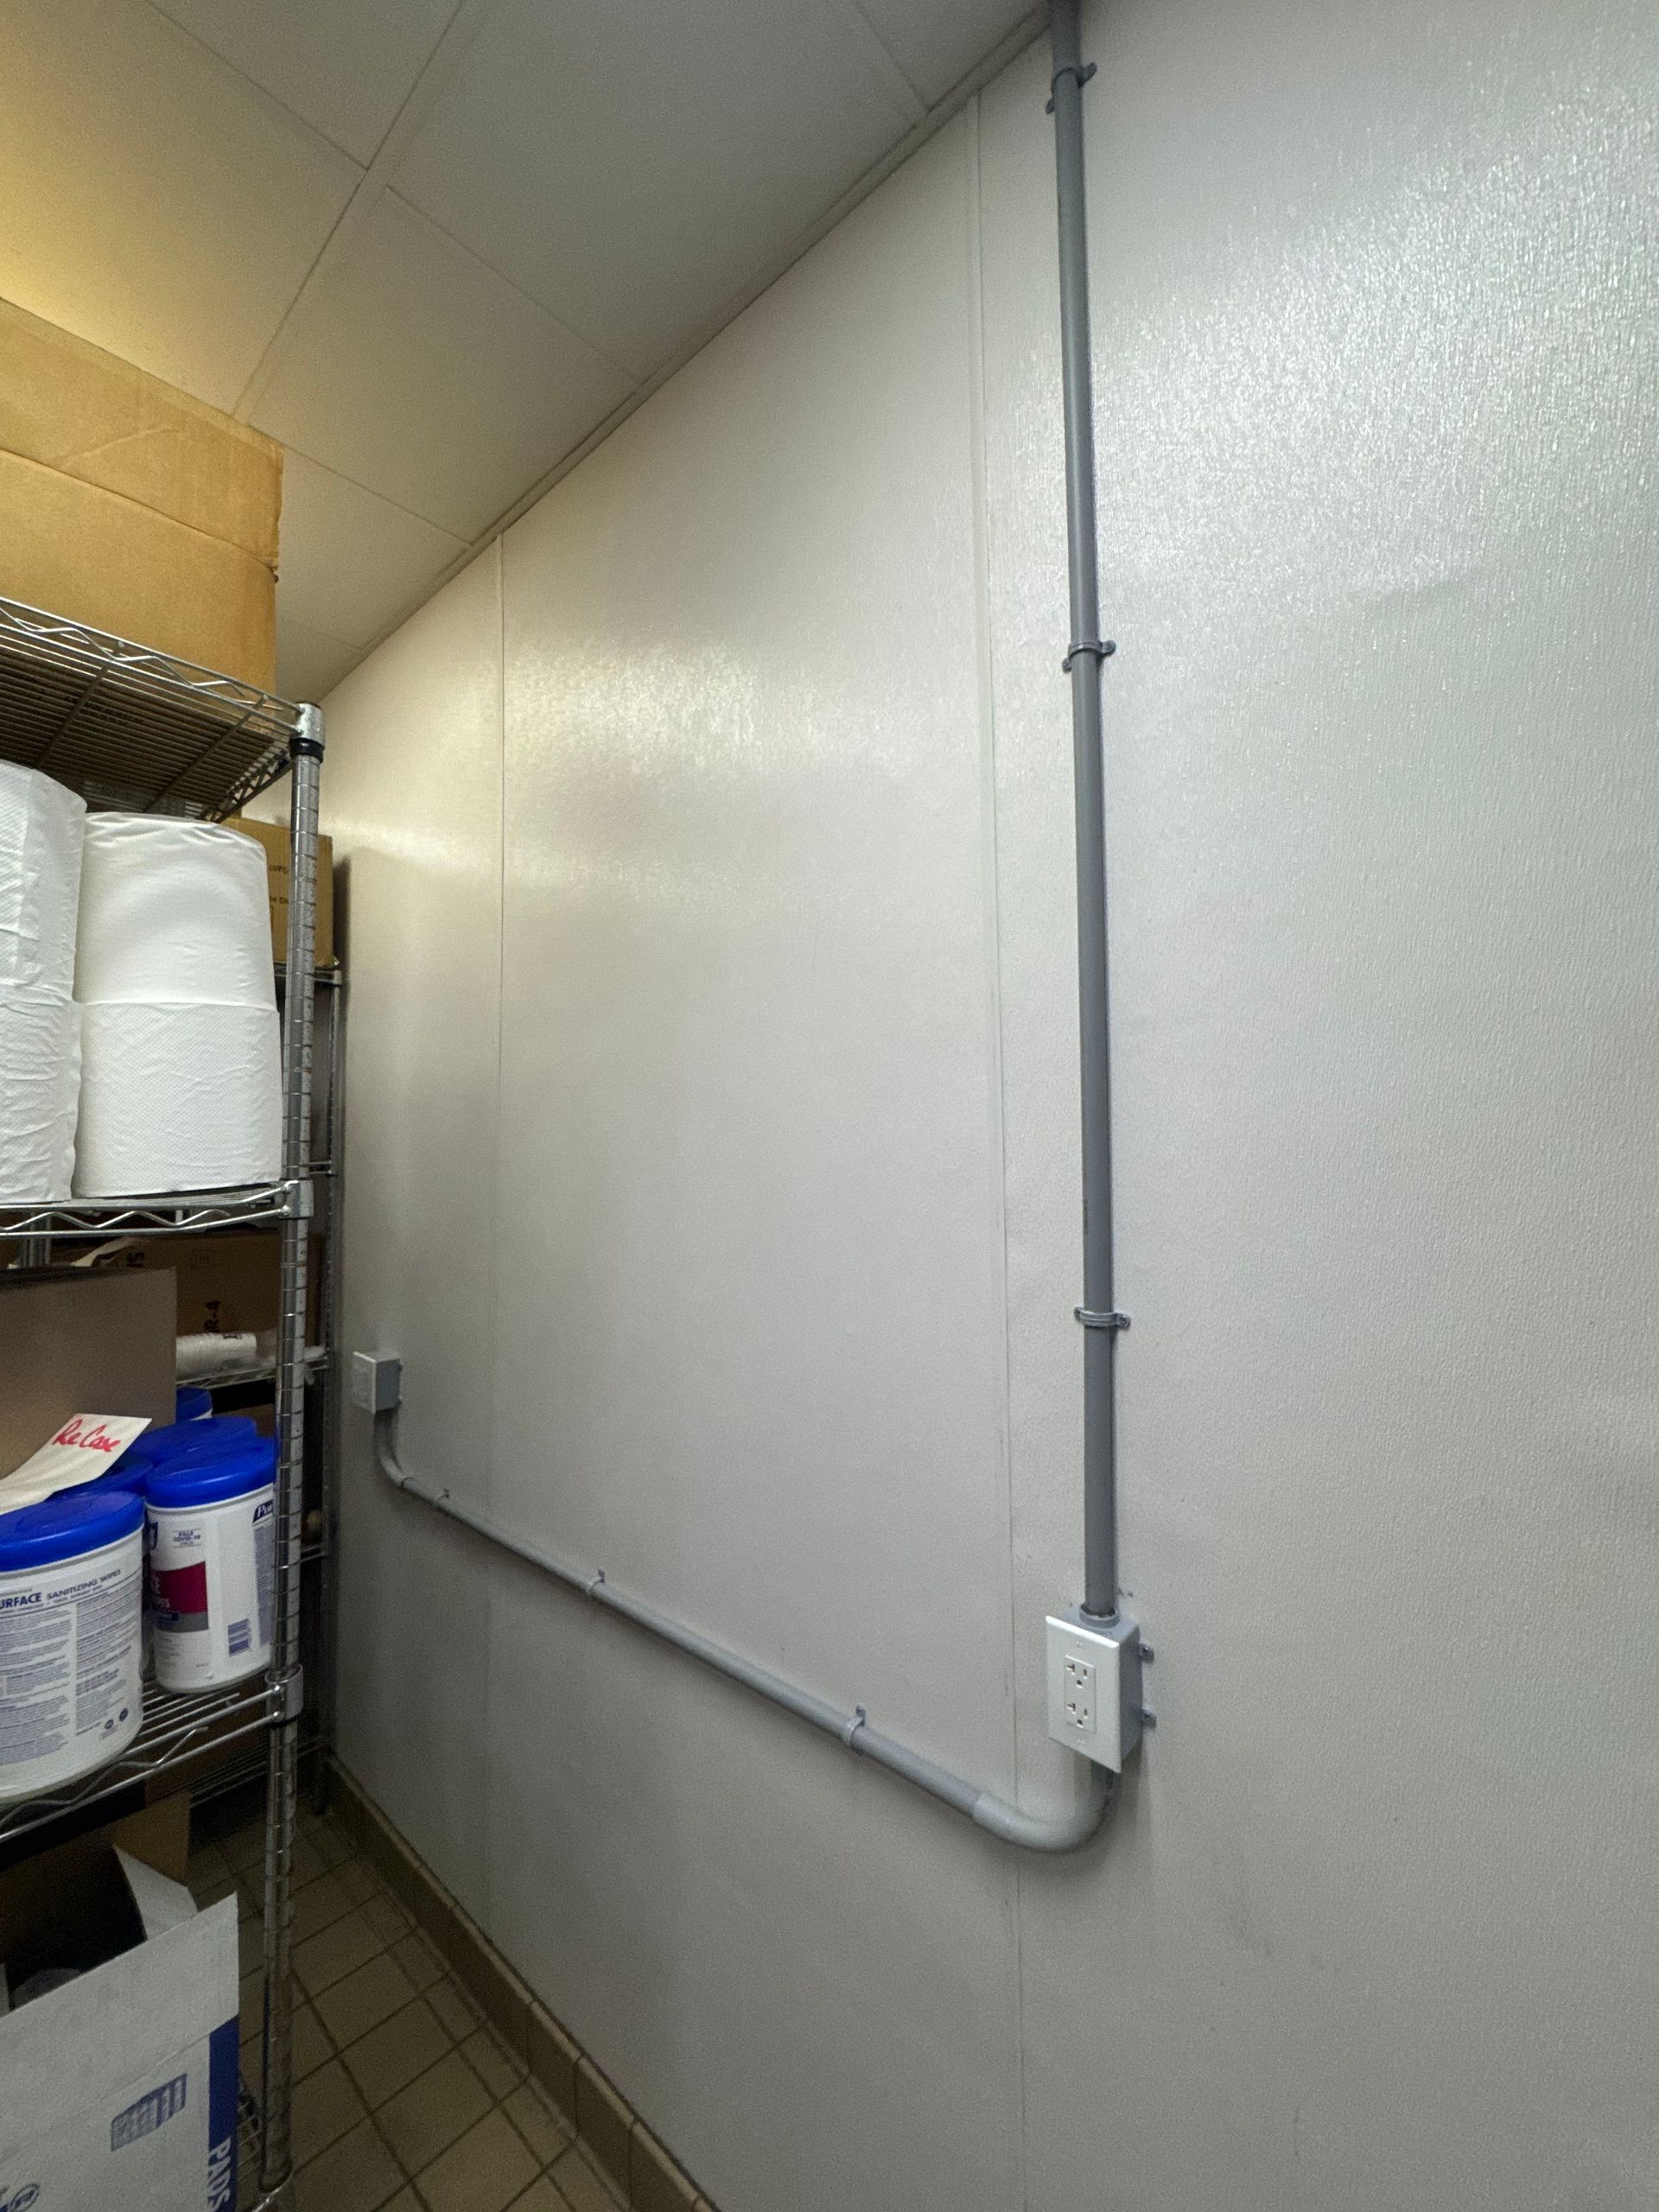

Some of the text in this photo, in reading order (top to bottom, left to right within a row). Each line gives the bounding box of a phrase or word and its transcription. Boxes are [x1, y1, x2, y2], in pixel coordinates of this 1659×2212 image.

[173, 1534, 201, 1542] COVID-19
[47, 1579, 98, 1600] SANITIZING
[99, 1568, 122, 1584] WIPES
[206, 2135, 232, 2212] PADS
